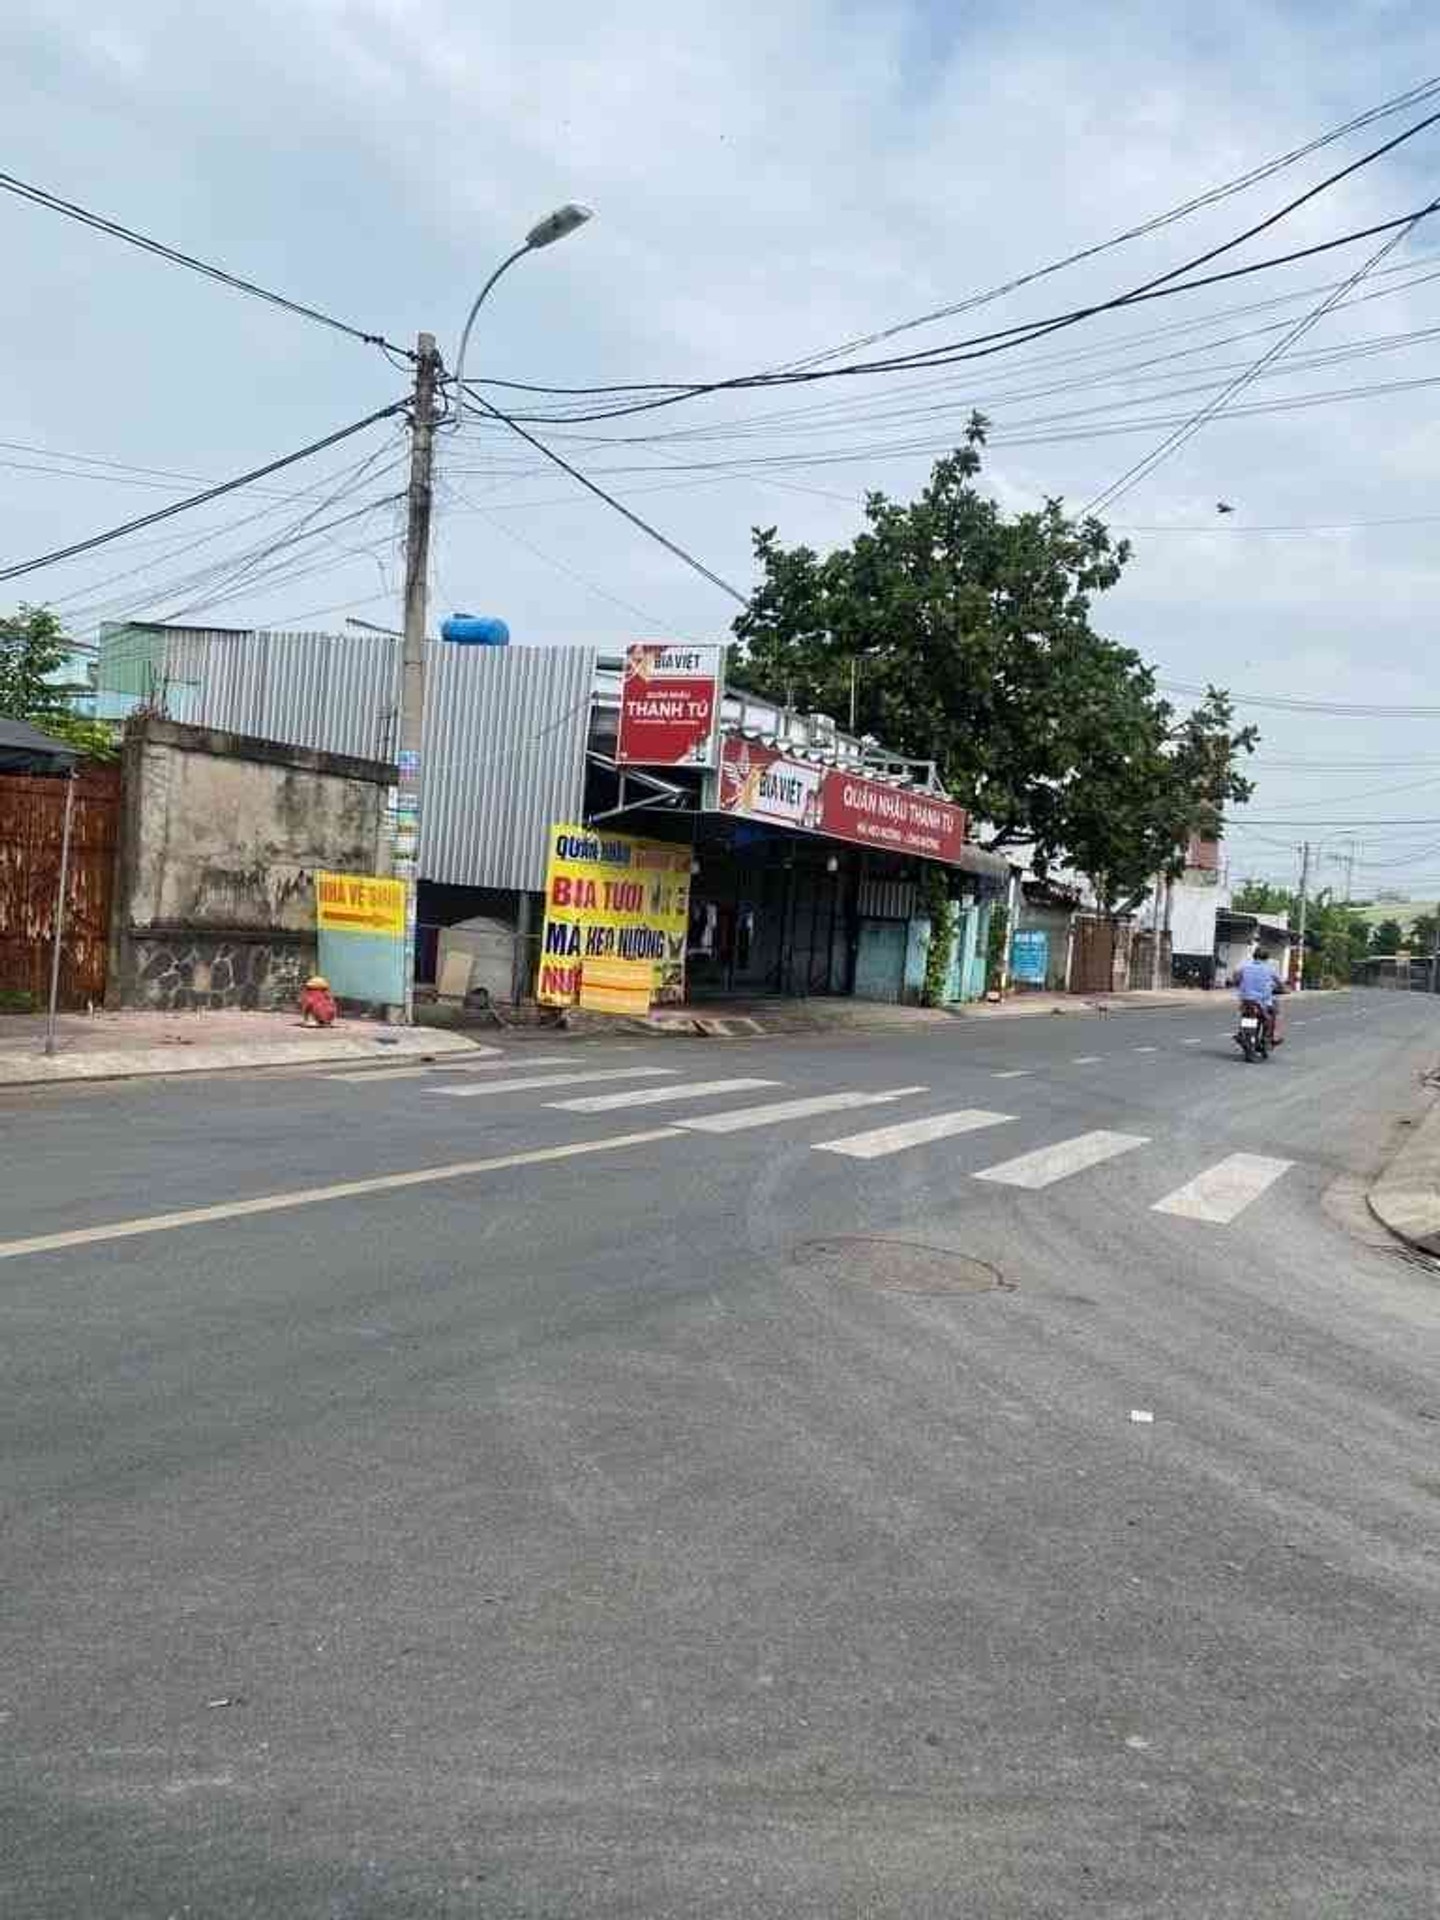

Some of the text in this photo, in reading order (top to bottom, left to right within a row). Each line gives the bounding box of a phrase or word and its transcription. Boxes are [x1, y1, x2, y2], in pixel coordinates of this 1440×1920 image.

[627, 699, 709, 718] THANH TÚ
[844, 784, 877, 813] QUÁN
[879, 794, 908, 824] NHẬU
[552, 875, 597, 911] BIA
